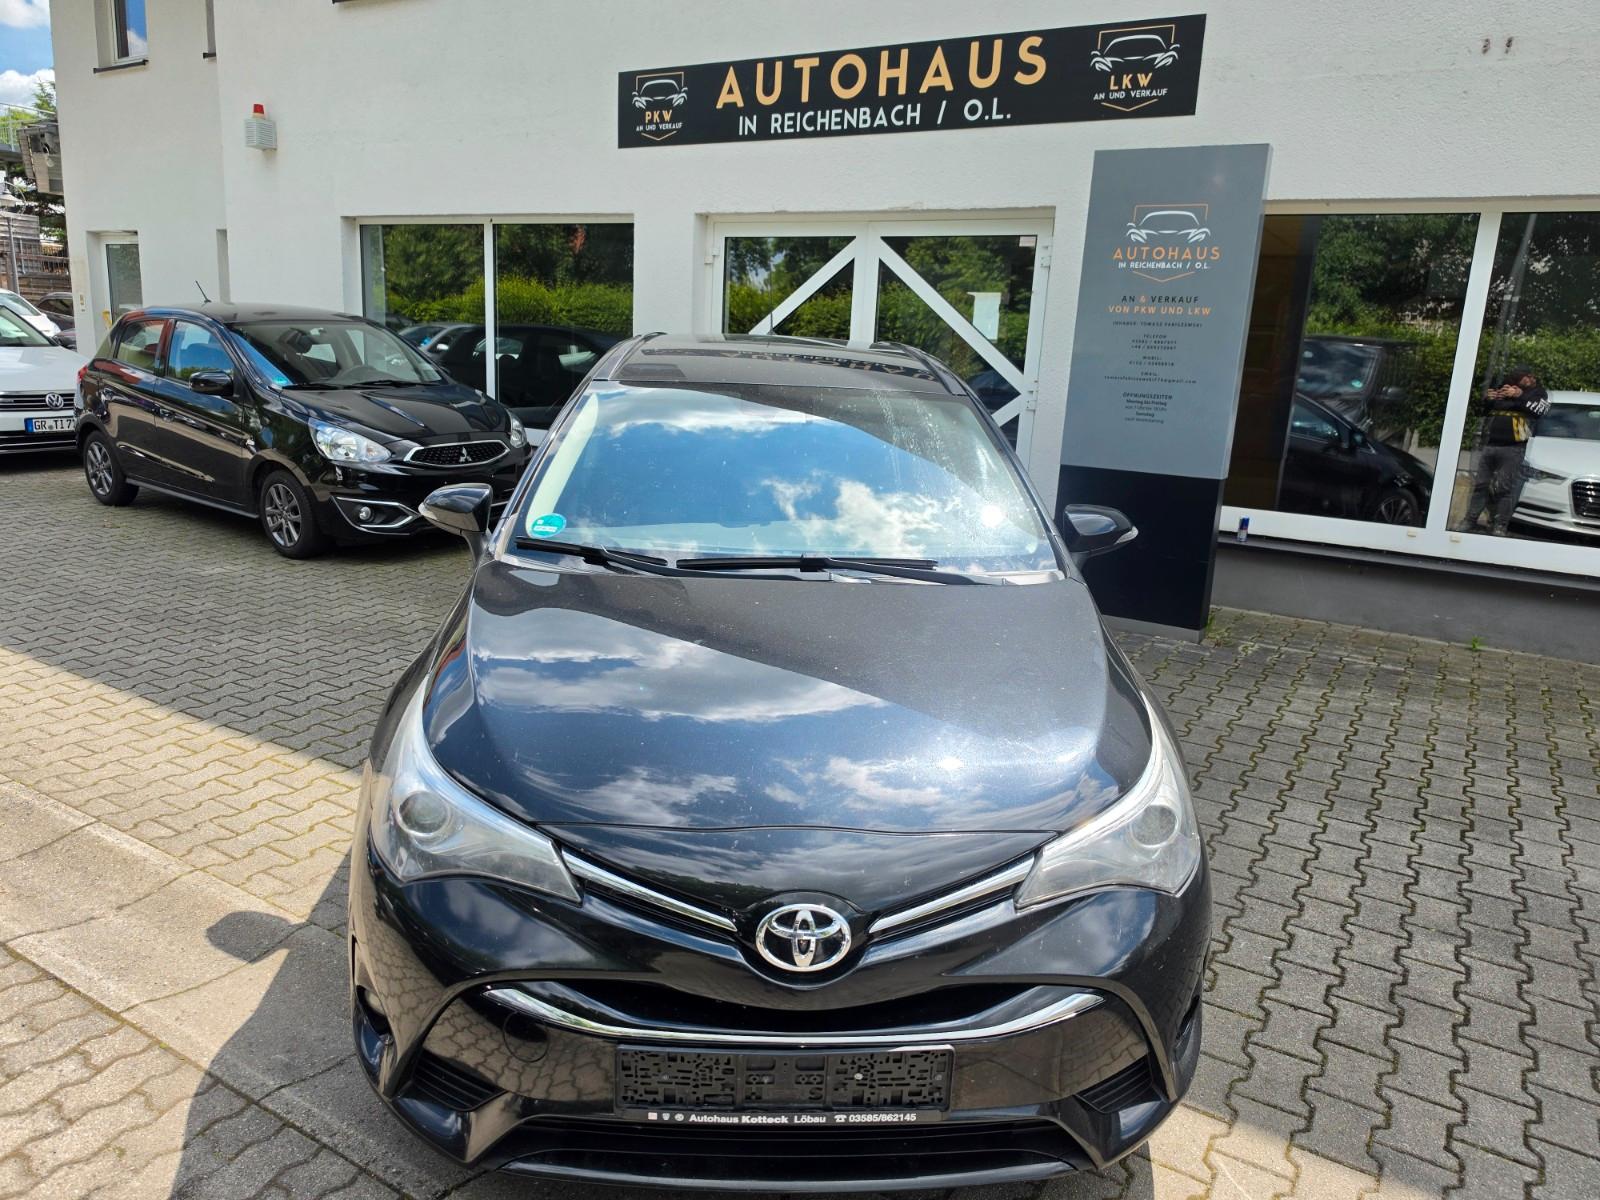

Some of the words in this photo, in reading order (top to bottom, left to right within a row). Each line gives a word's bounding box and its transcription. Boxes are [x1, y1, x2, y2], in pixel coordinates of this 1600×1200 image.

[716, 35, 1048, 110] AUTOHAUS
[1109, 72, 1153, 90] LKW
[1093, 92, 1105, 101] AN
[1109, 91, 1126, 99] UND
[1130, 88, 1168, 98] VERKAUF
[645, 109, 673, 123] PKW
[738, 114, 758, 136] IN
[769, 100, 922, 135] REICHENBACH
[937, 99, 948, 125] /
[963, 95, 1013, 122] O.L.
[659, 122, 683, 130] VERKAUF
[1112, 246, 1222, 260] AUTOHAUS
[1121, 295, 1136, 303] AN
[1151, 295, 1200, 303] VERKAUF
[1108, 305, 1130, 314] VON
[1134, 306, 1157, 314] PKW
[1160, 306, 1184, 315] UND
[1187, 307, 1212, 316] LKW
[34, 420, 47, 430] GR
[689, 1113, 740, 1124] Autohaus
[741, 1114, 789, 1124] Kotteck
[794, 1113, 827, 1124] Löbau
[848, 1113, 917, 1123] 03585/862145
